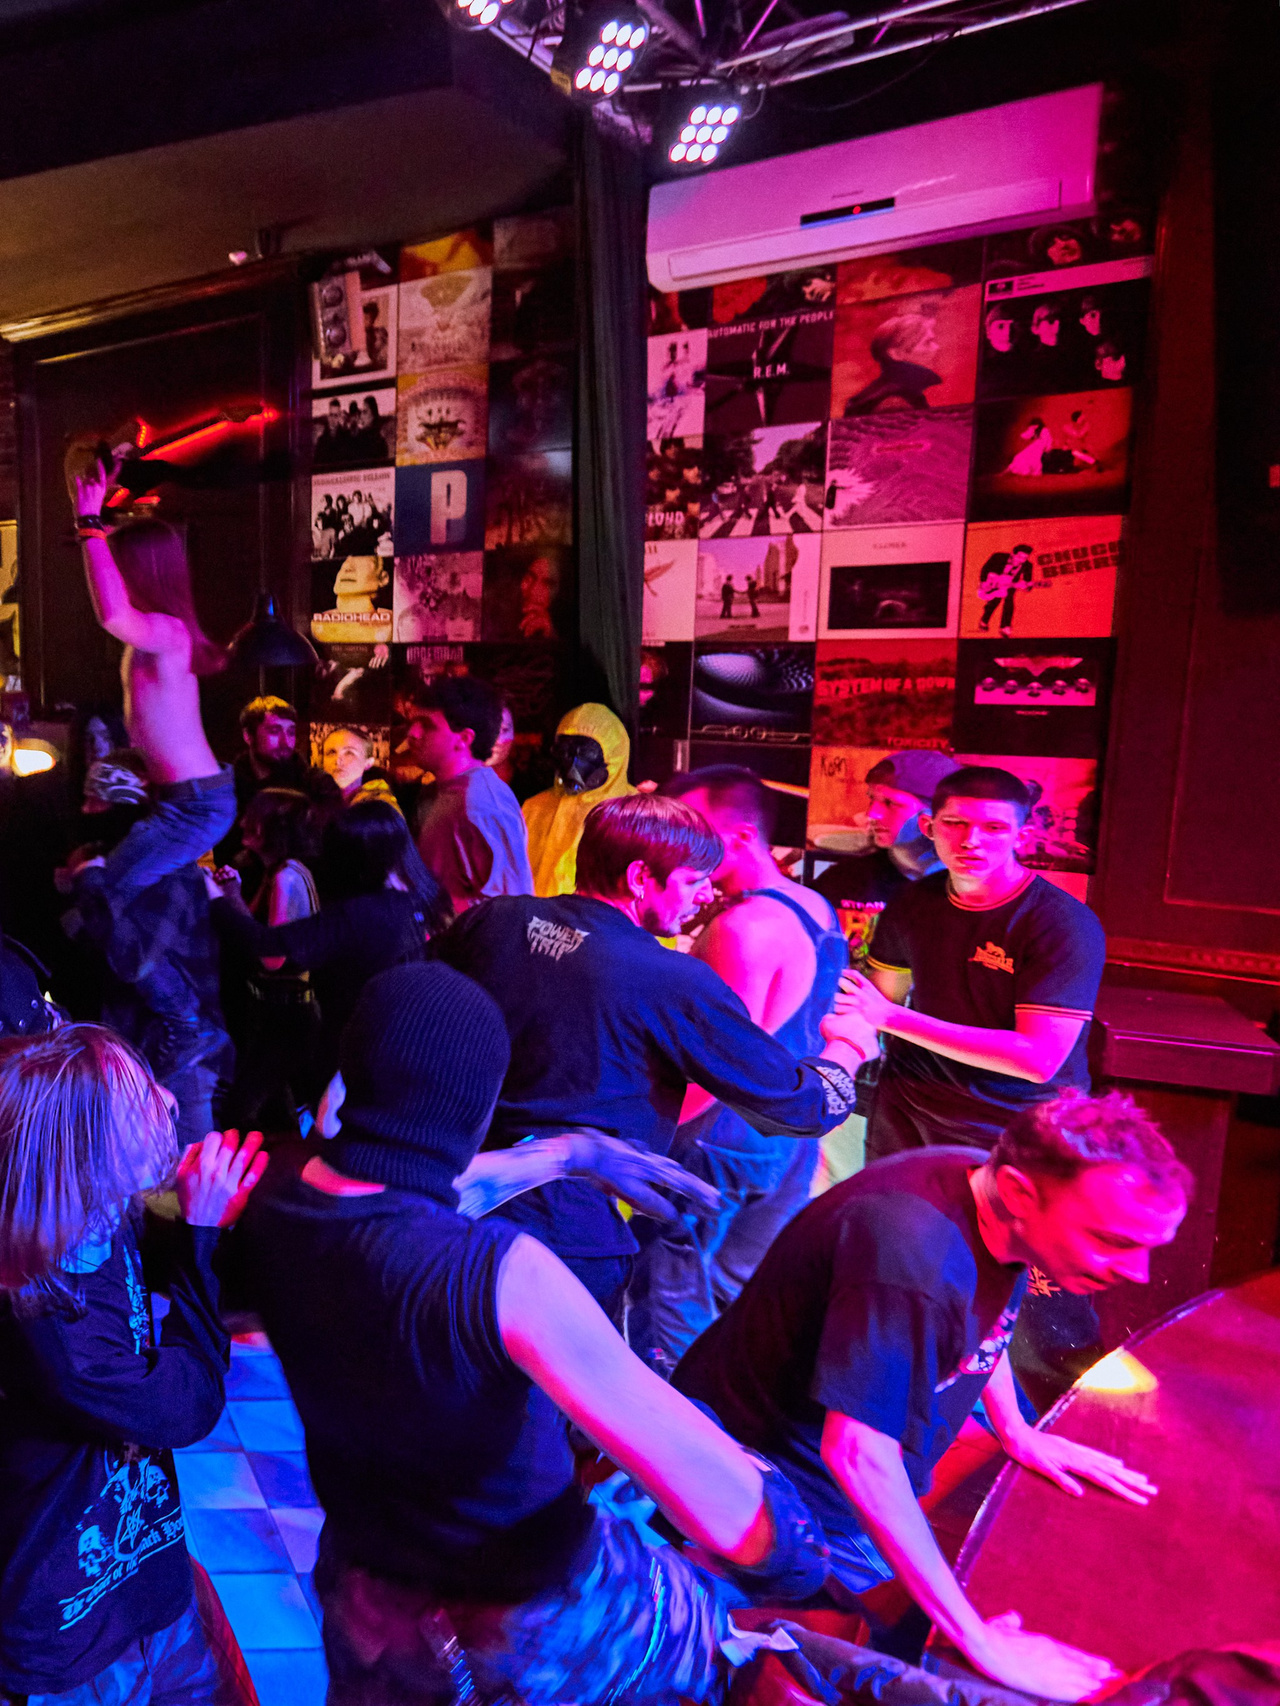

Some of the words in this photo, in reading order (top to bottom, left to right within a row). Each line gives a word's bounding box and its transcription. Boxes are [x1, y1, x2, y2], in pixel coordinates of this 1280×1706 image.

[707, 322, 756, 340] AUTOMATIC
[758, 318, 778, 331] FOR
[779, 315, 798, 329] THE
[799, 309, 835, 324] PEOPLE
[753, 362, 791, 379] R.E.M.
[430, 469, 468, 544] P
[313, 611, 391, 622] RADIOHEAD
[816, 677, 882, 699] SYSTEM
[883, 677, 901, 692] OF
[903, 678, 913, 690] A
[915, 676, 956, 691] DOWN
